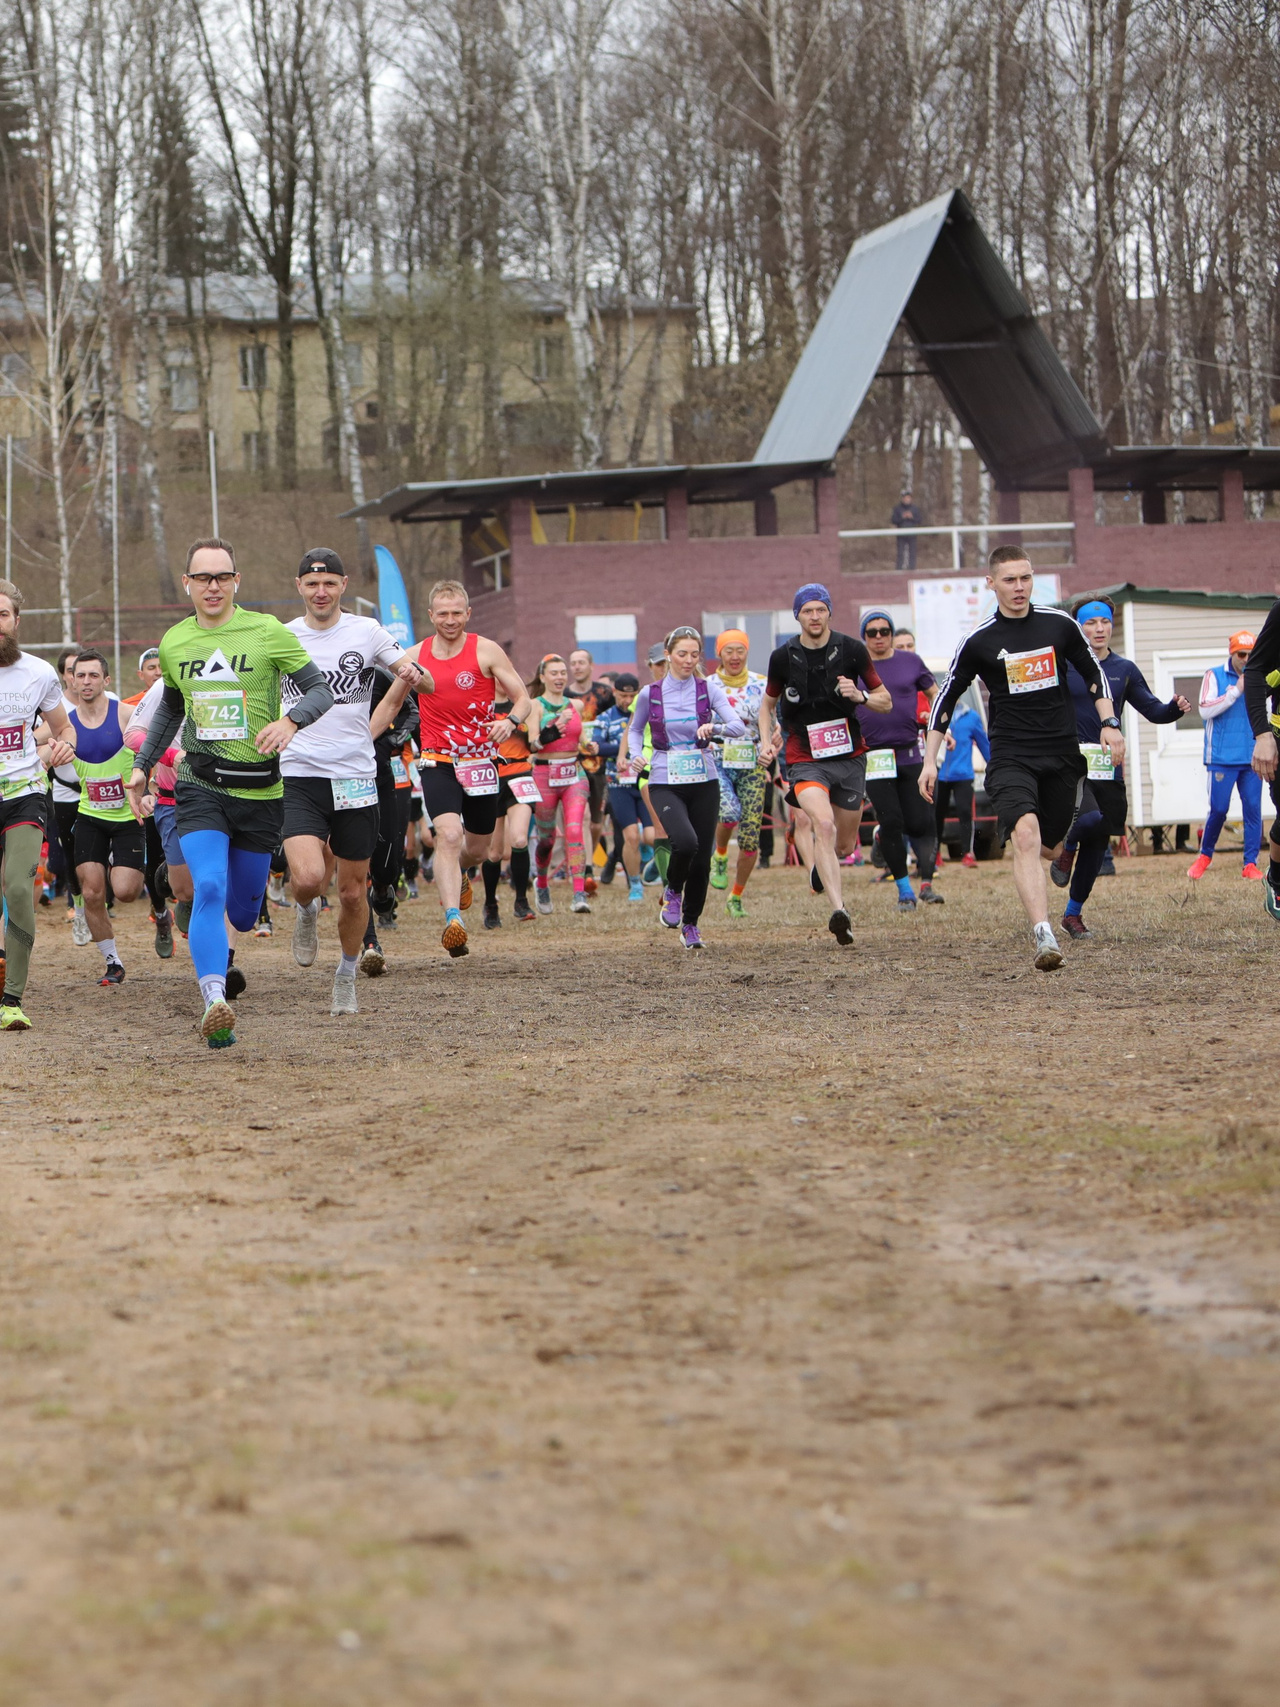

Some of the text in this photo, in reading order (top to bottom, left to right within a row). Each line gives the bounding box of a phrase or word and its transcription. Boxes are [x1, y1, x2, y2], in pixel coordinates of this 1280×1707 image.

[1024, 659, 1050, 676] 241
[207, 704, 241, 721] 742
[823, 729, 847, 743] 825
[736, 748, 753, 758] 705
[682, 758, 704, 771] 384
[872, 757, 893, 767] 764
[1089, 754, 1112, 766] 736
[470, 768, 495, 782] 870
[560, 765, 576, 775] 879
[98, 784, 122, 797] 821
